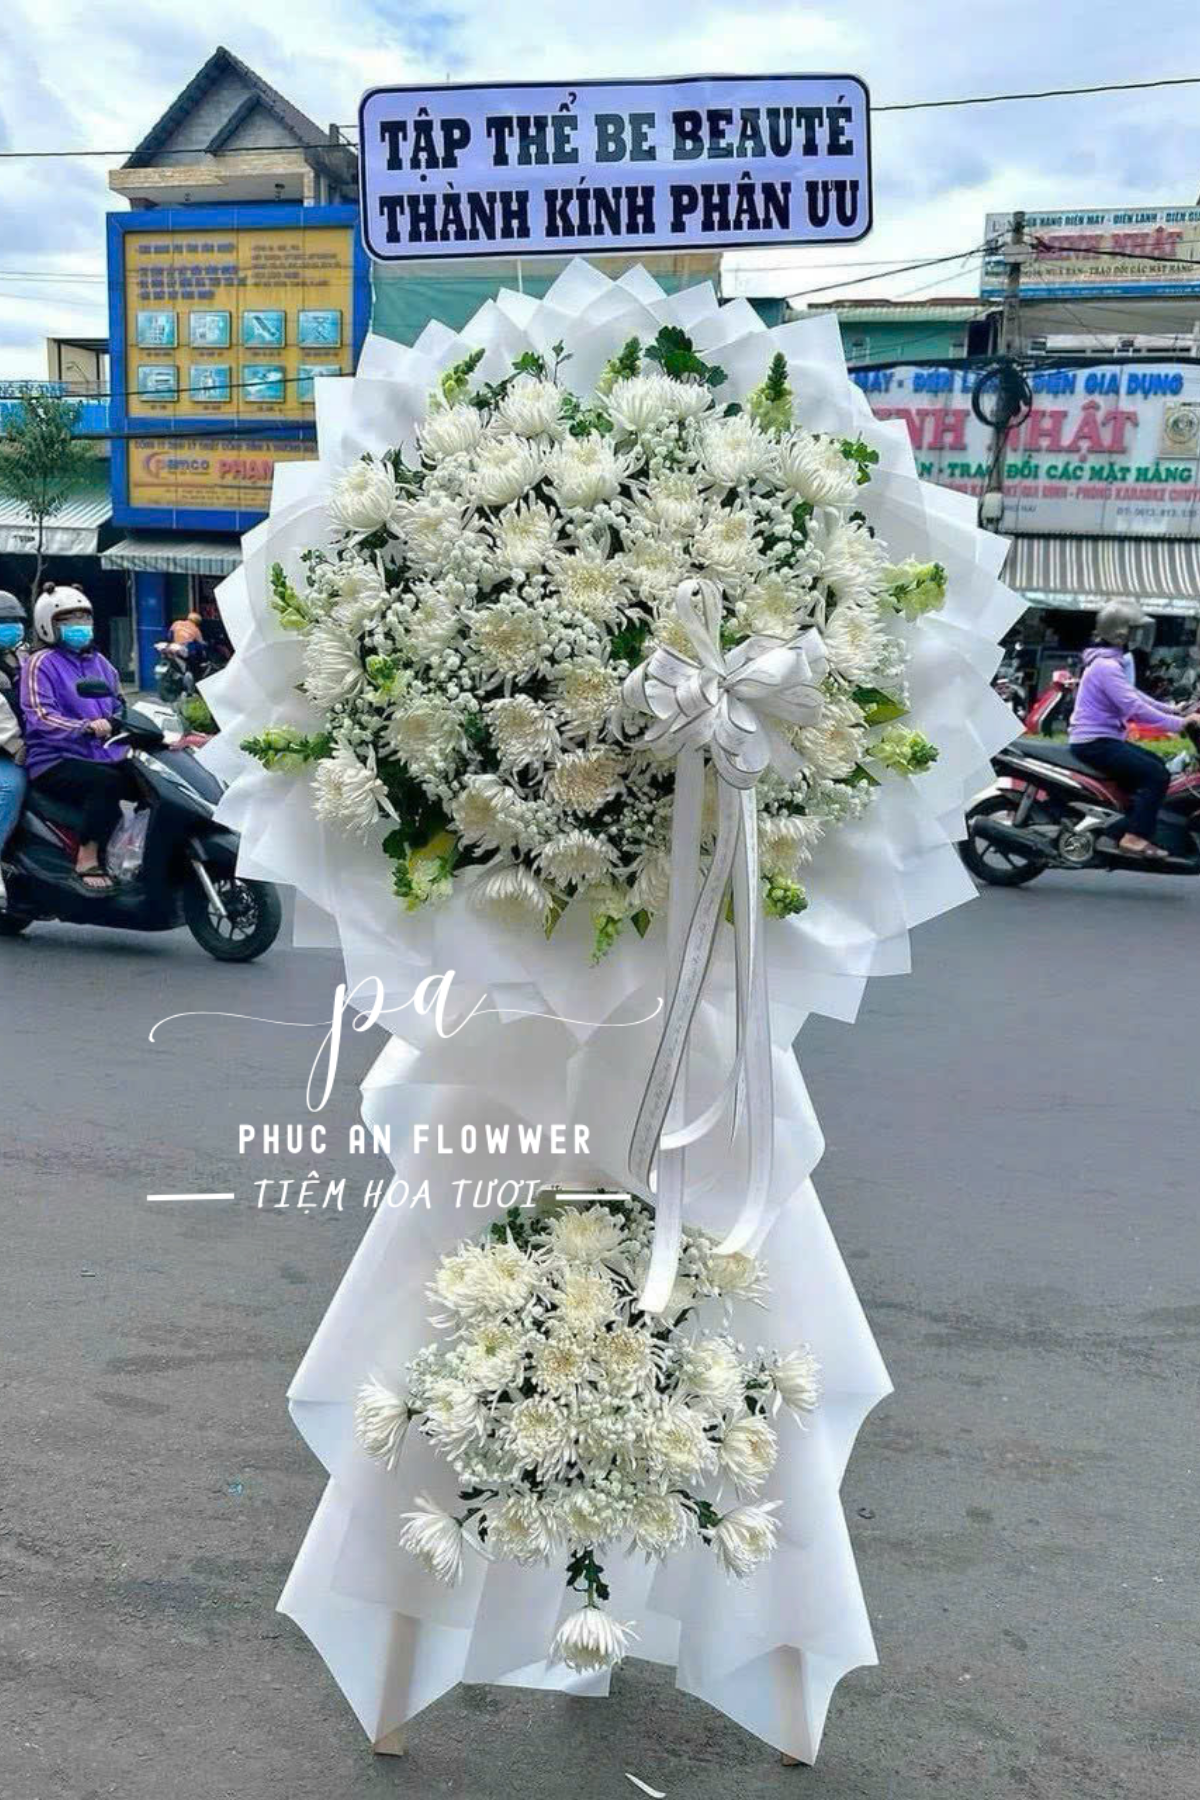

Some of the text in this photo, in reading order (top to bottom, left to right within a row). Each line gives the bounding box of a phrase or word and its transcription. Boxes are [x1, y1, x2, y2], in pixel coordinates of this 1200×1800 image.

[379, 92, 854, 182] TẬP THỂ BE BEAUTÉ
[379, 171, 859, 243] THÀNH KÍNH PHÂN ƯU
[1084, 373, 1120, 395] GIA
[1126, 373, 1184, 400] DỤNG
[947, 460, 989, 479] TRA
[1005, 453, 1039, 480] ĐỔI
[1045, 461, 1084, 481] CÁC
[1088, 461, 1131, 484] MẶT
[1135, 460, 1193, 483] HÀNG
